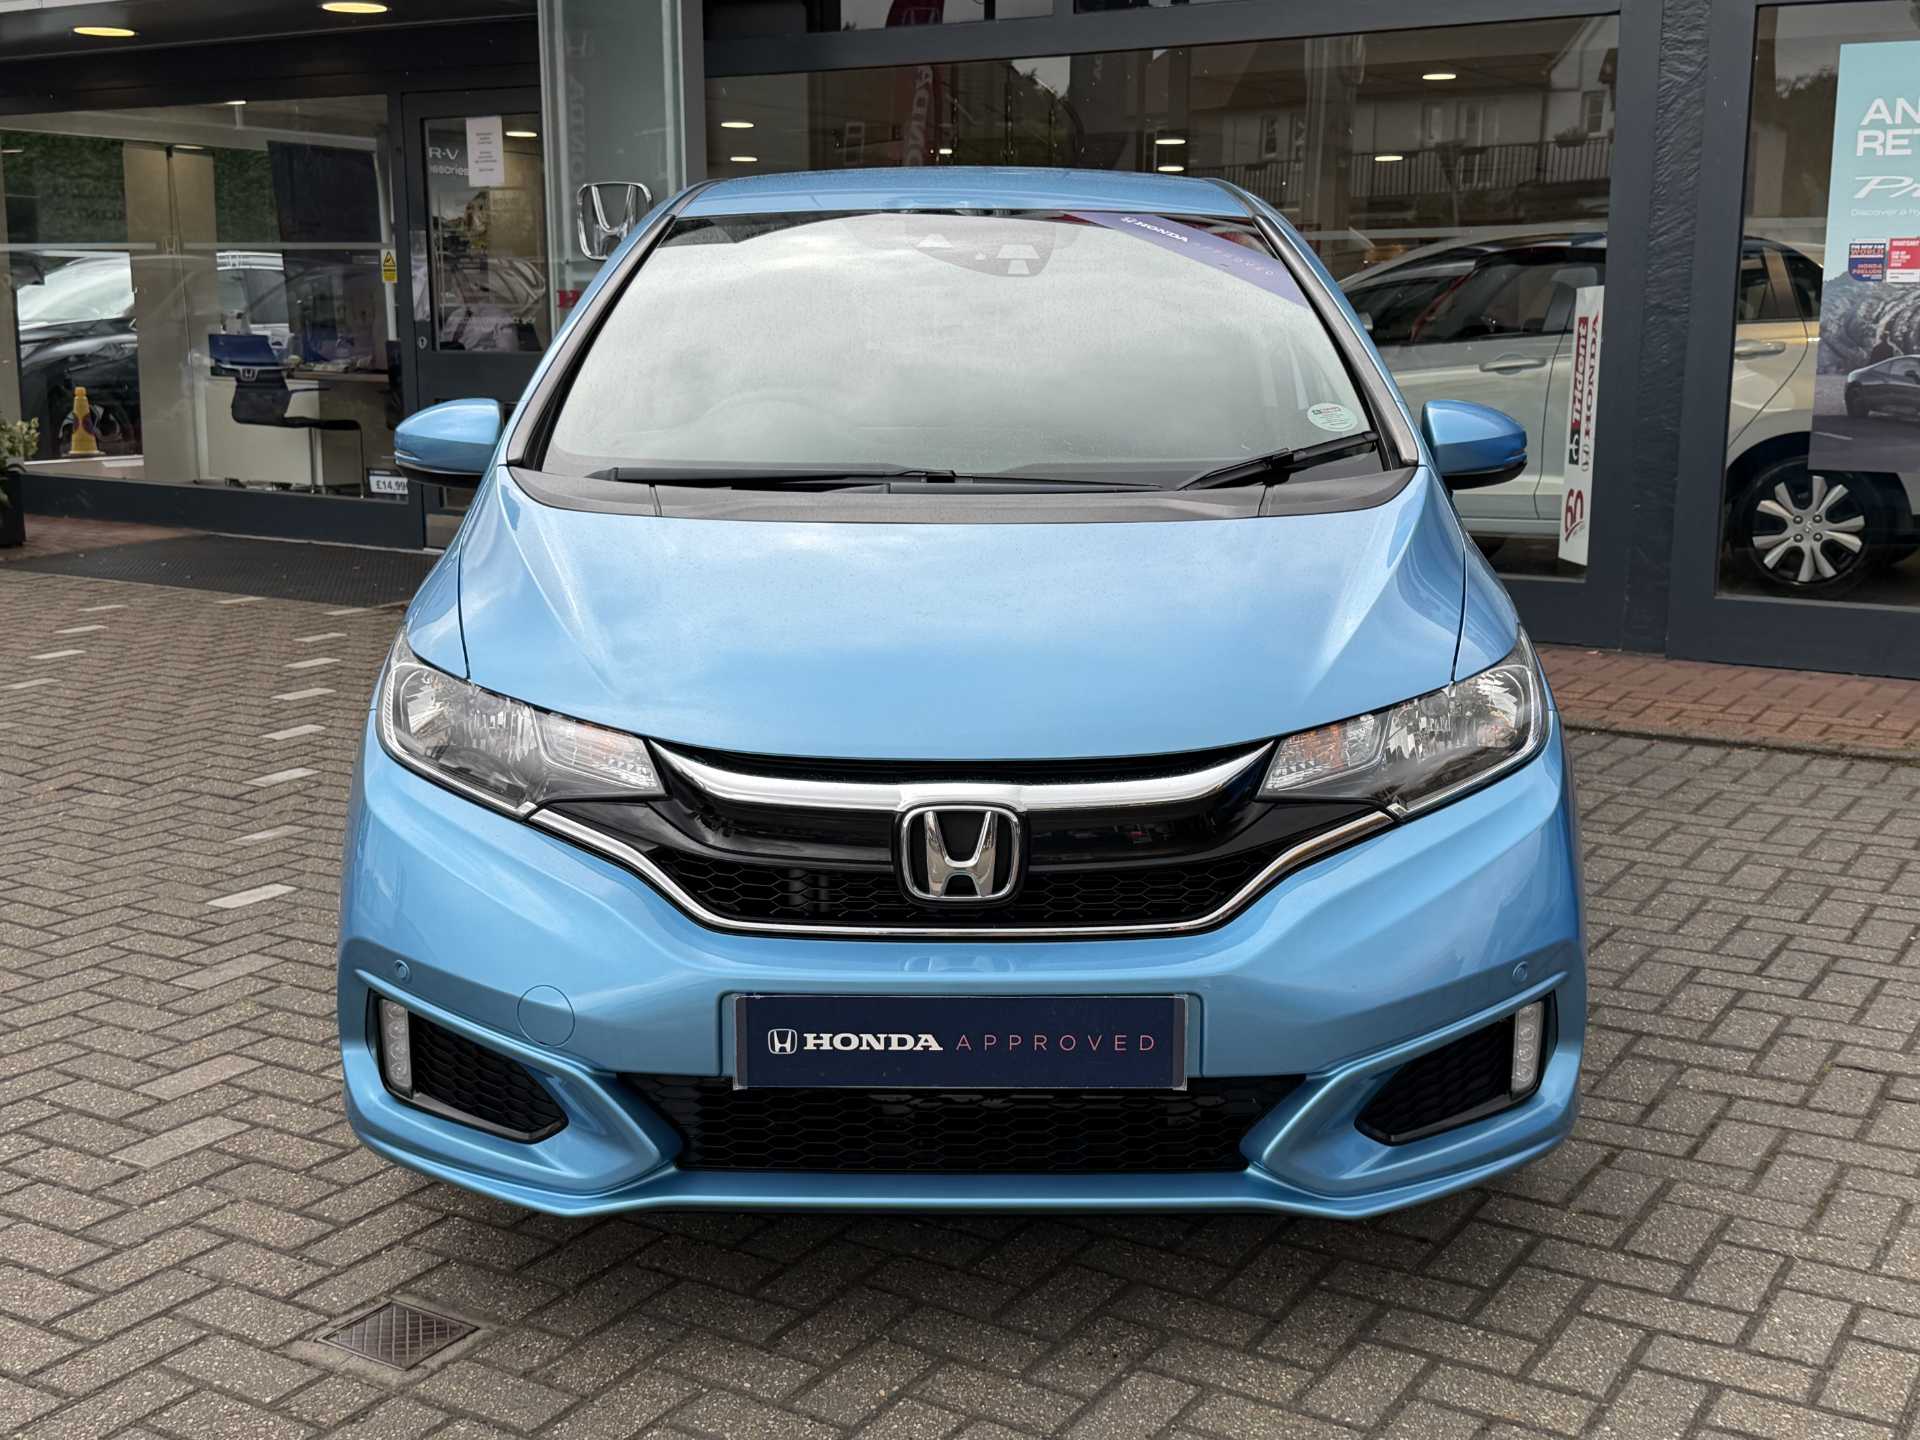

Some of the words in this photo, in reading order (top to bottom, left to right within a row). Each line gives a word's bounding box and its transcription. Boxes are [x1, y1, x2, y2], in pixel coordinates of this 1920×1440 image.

[1134, 220, 1189, 243] HONDA
[1571, 323, 1589, 424] Trident
[1583, 311, 1600, 440] HONDA
[803, 1033, 944, 1052] HONDA
[956, 1033, 1156, 1052] APPROVED
